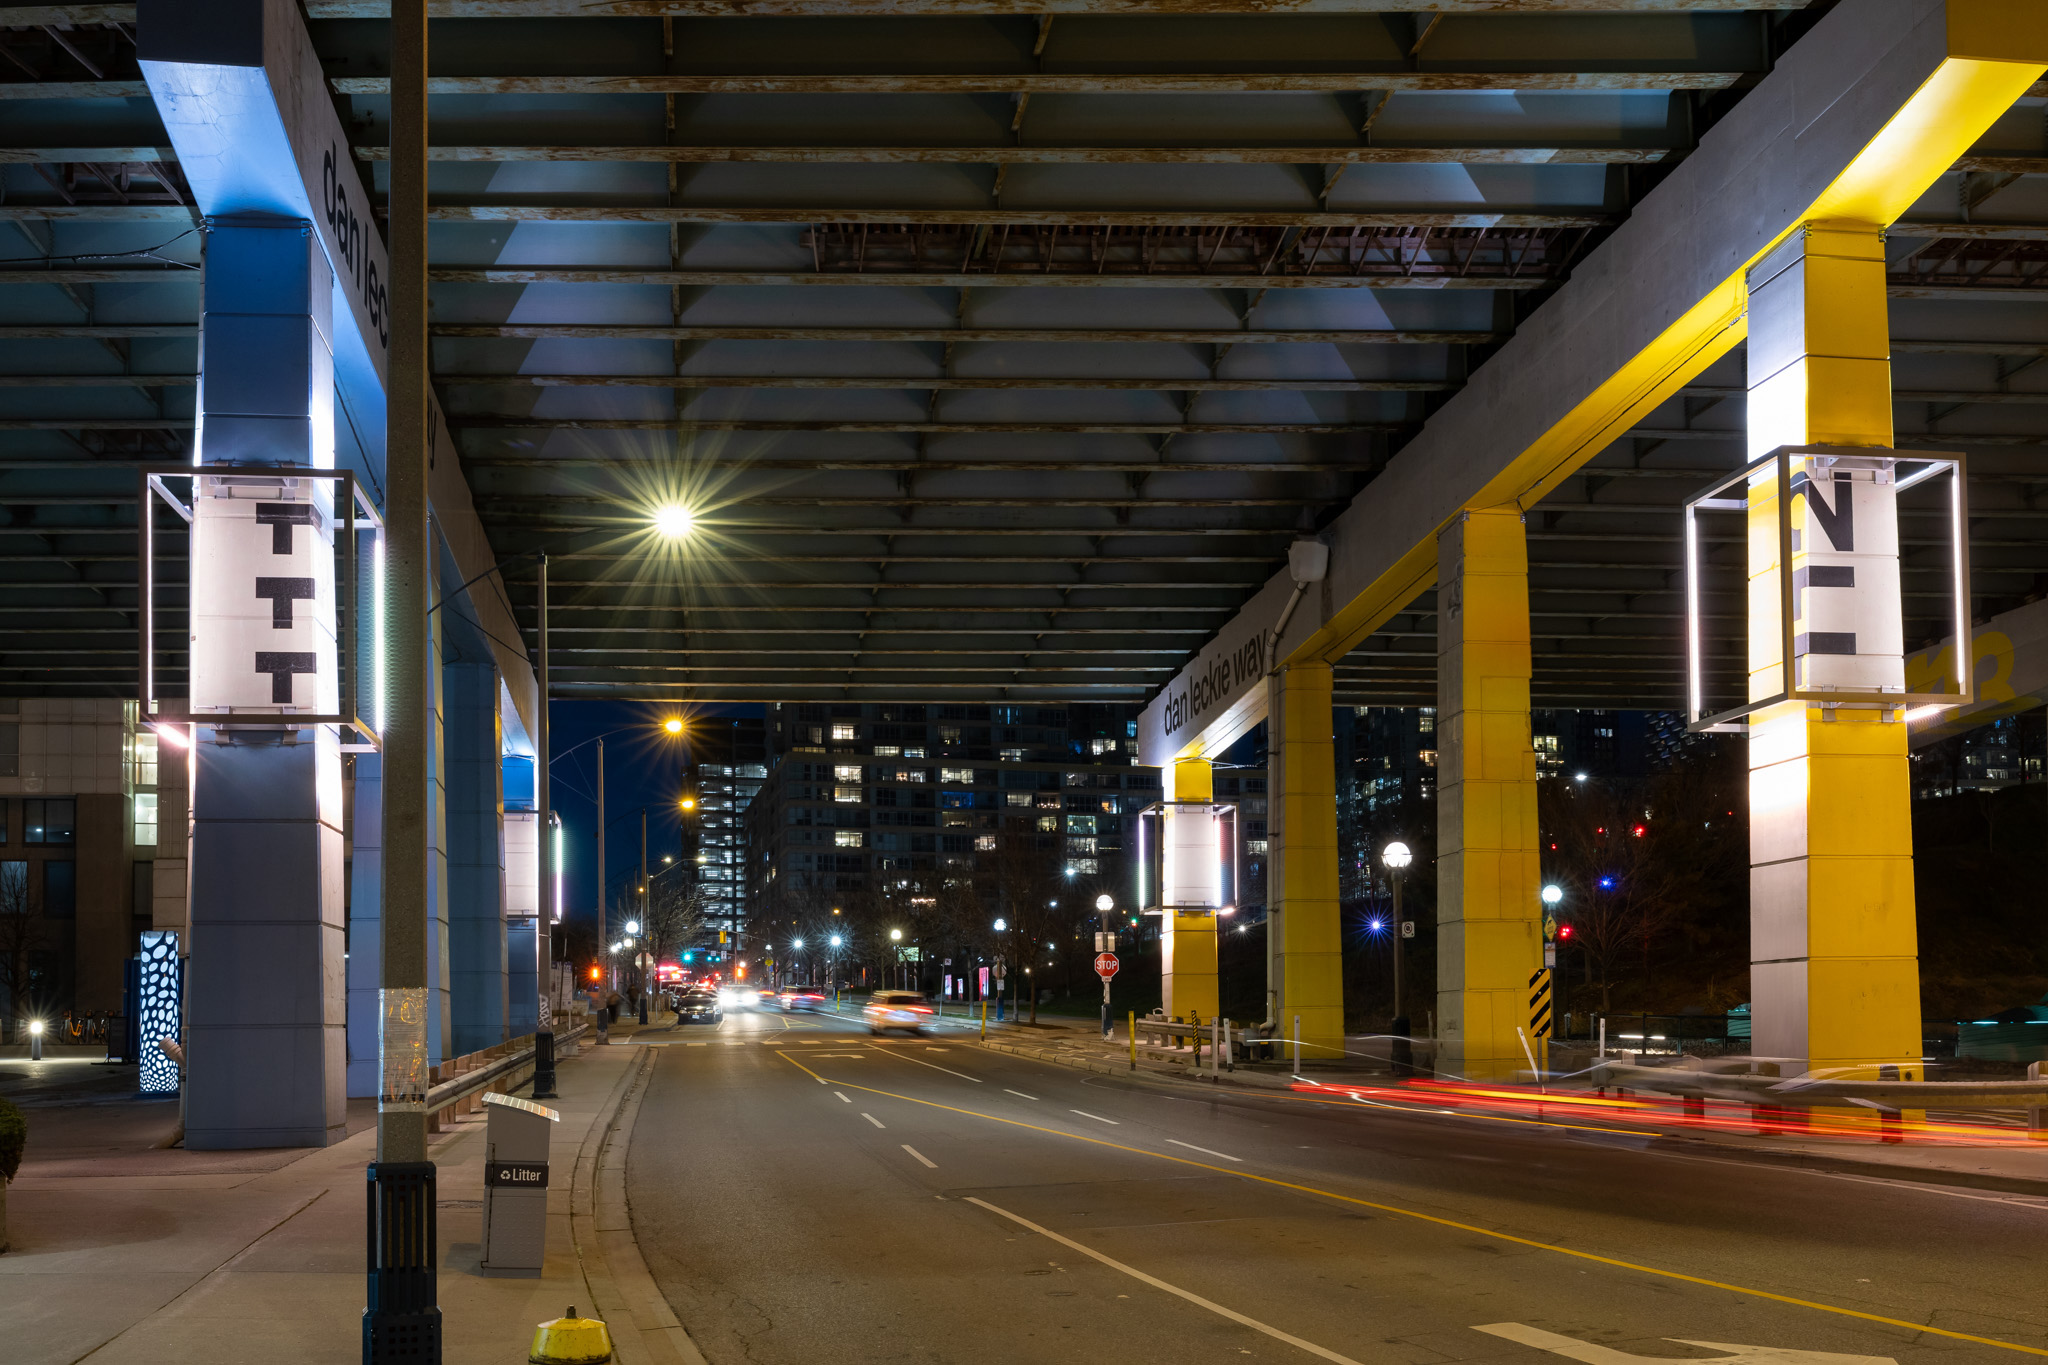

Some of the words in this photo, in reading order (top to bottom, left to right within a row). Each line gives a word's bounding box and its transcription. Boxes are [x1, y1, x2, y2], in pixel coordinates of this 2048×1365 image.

[323, 139, 361, 292] dan
[363, 220, 388, 350] lec
[1165, 688, 1187, 736] dan
[1190, 653, 1230, 719] leckie
[1233, 628, 1267, 687] way
[1096, 960, 1118, 970] STOP
[512, 1168, 541, 1182] Litter
